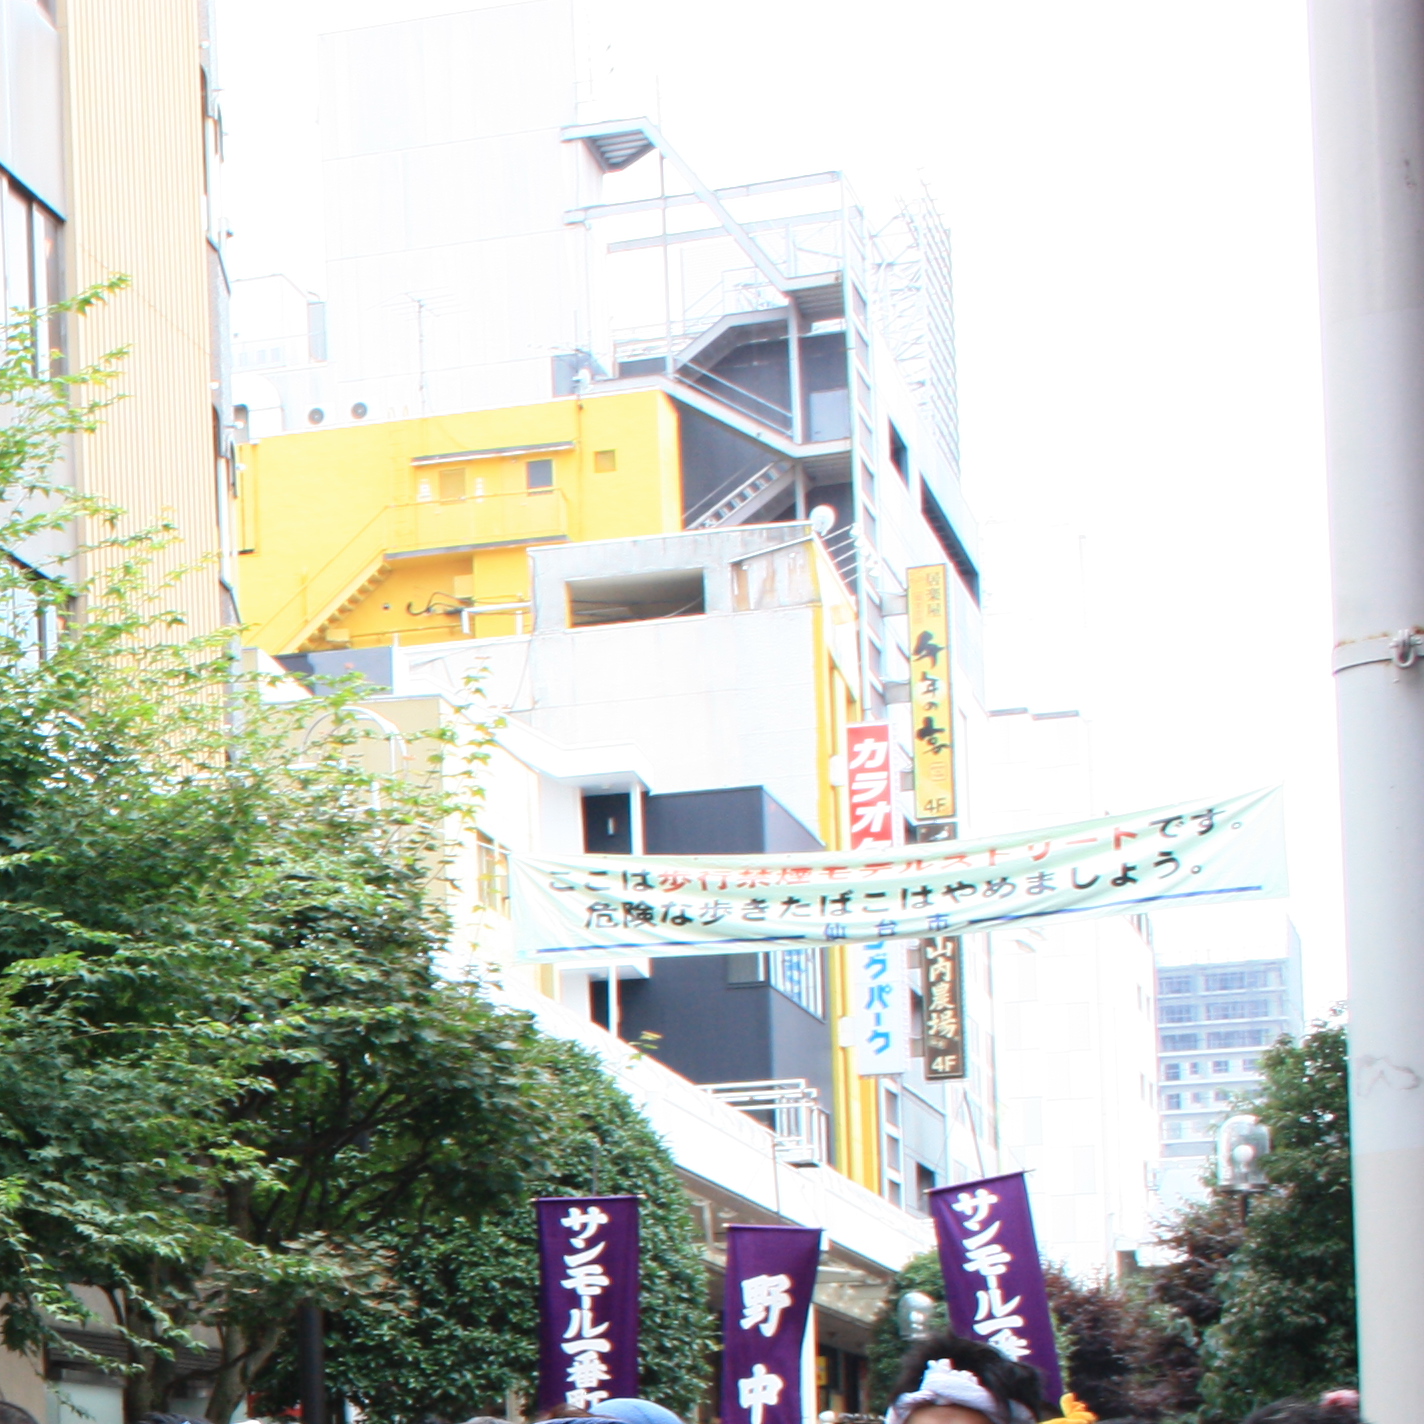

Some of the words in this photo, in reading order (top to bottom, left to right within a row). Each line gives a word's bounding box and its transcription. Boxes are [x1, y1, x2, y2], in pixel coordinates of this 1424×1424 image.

[922, 797, 948, 814] 4F
[583, 850, 1202, 930] 危険な歩きたばこはやめましょう。
[823, 912, 950, 941] 仙台市
[931, 1054, 957, 1073] 4F
